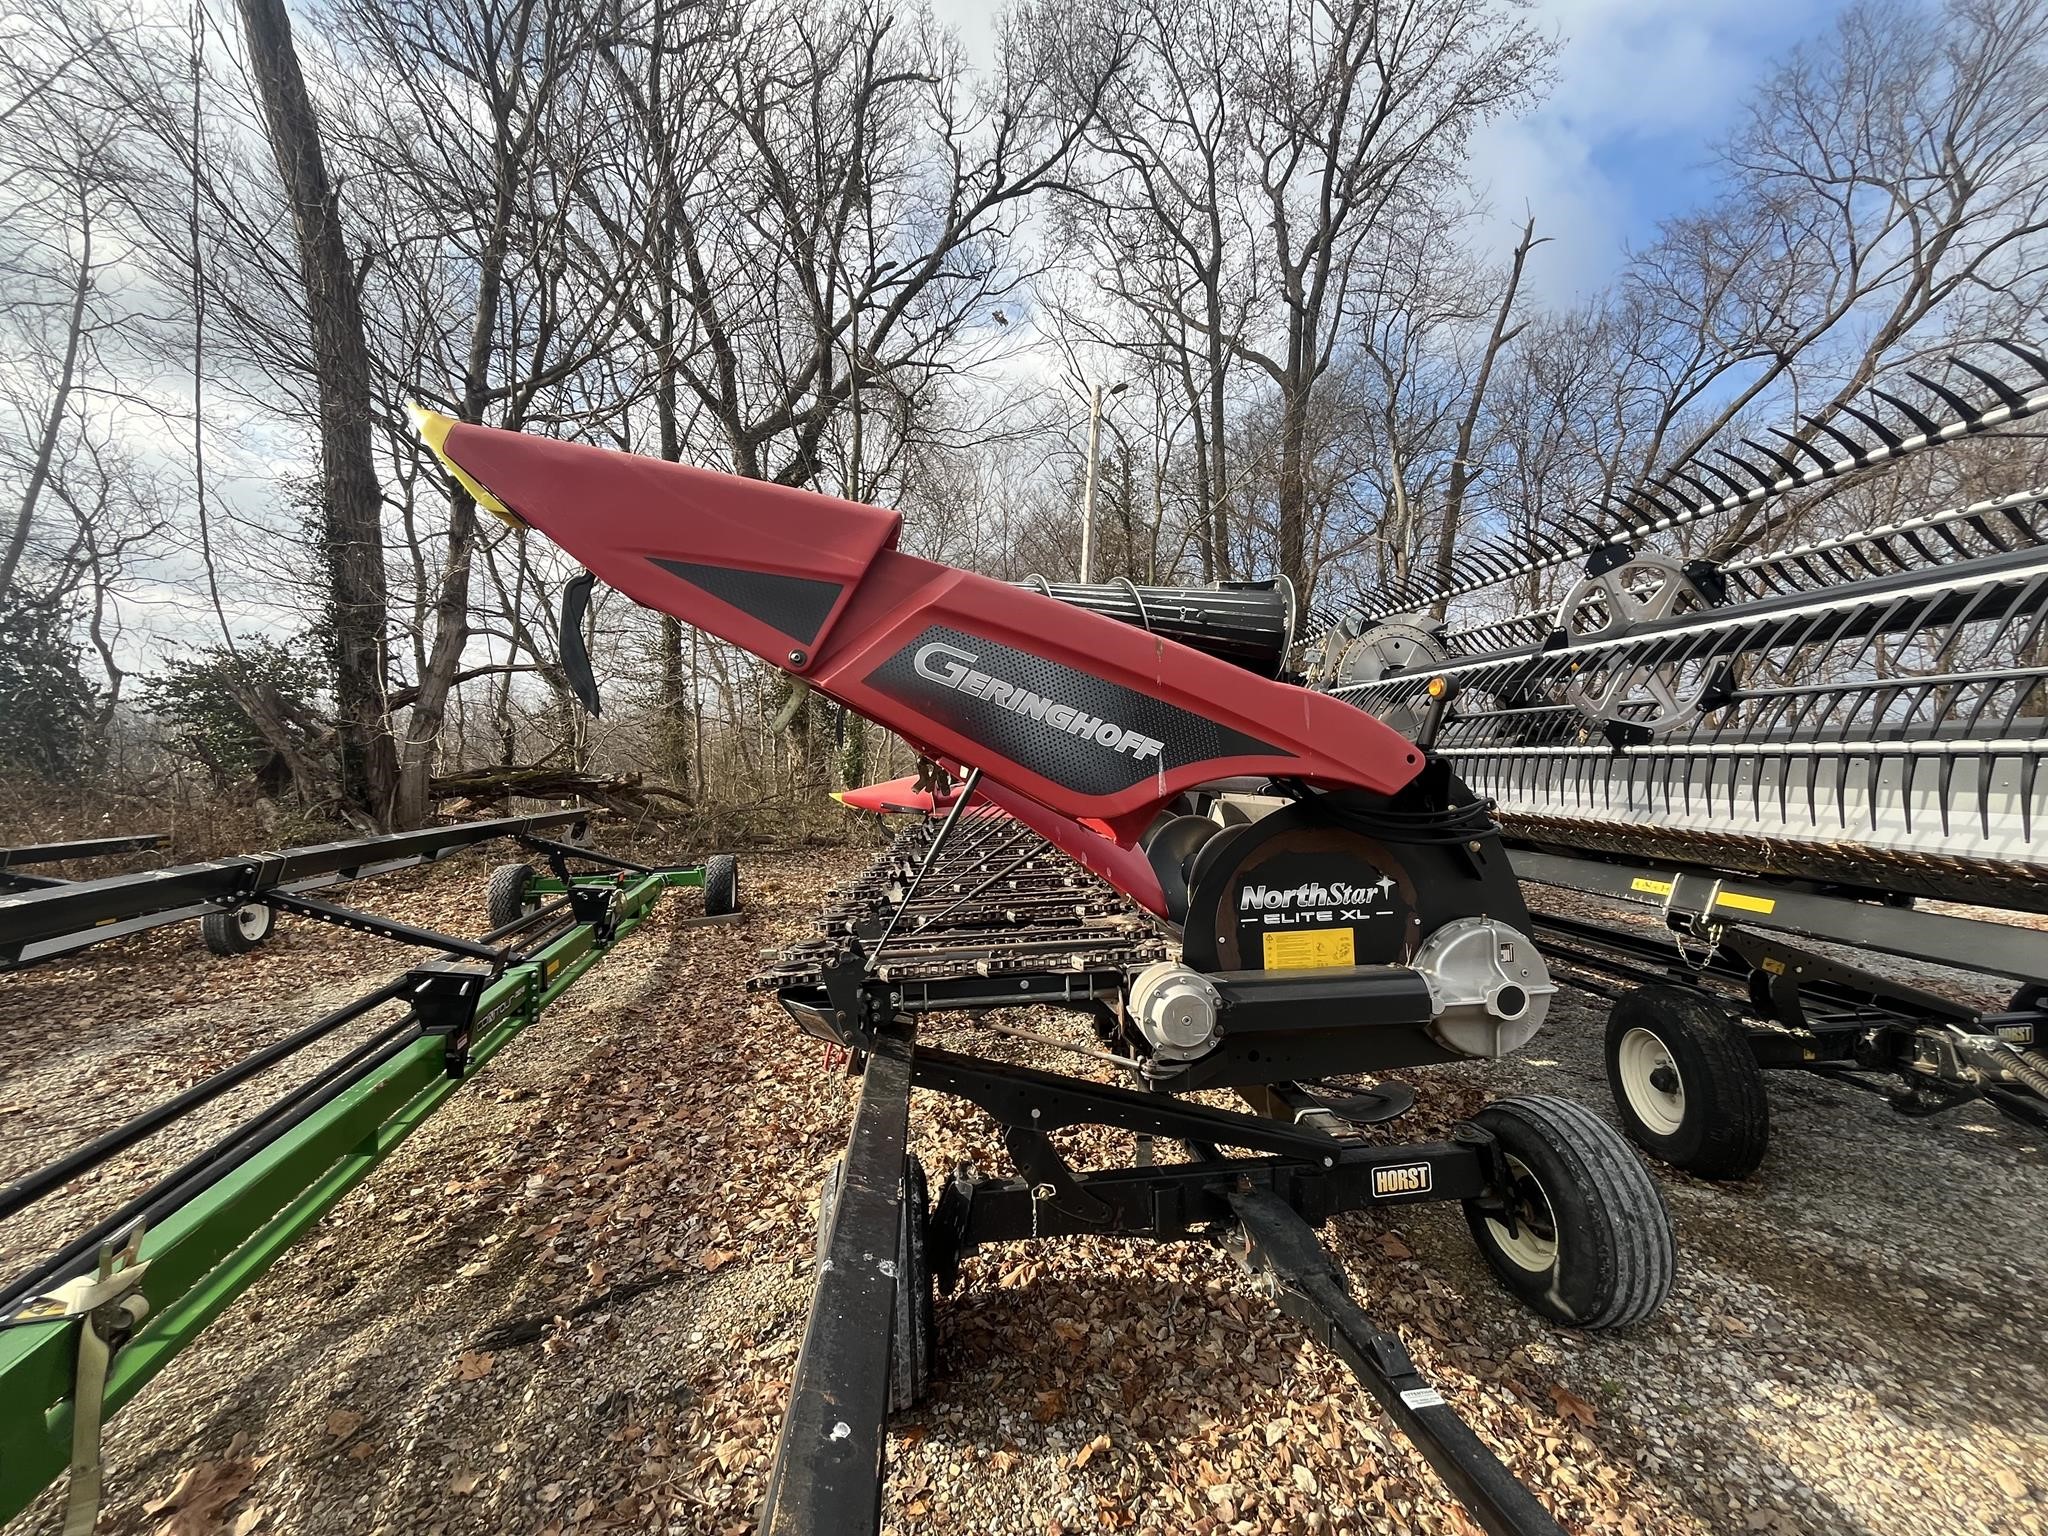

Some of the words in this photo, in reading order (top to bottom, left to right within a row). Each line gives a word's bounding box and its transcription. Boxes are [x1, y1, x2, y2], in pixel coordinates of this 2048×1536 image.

[913, 642, 1165, 761] GERINGHOFF
[1240, 882, 1379, 910] NorthStar
[1263, 910, 1333, 925] ELITE
[1339, 909, 1371, 921] XL
[1998, 1026, 2031, 1041] HORST
[1376, 1167, 1428, 1193] HORST
